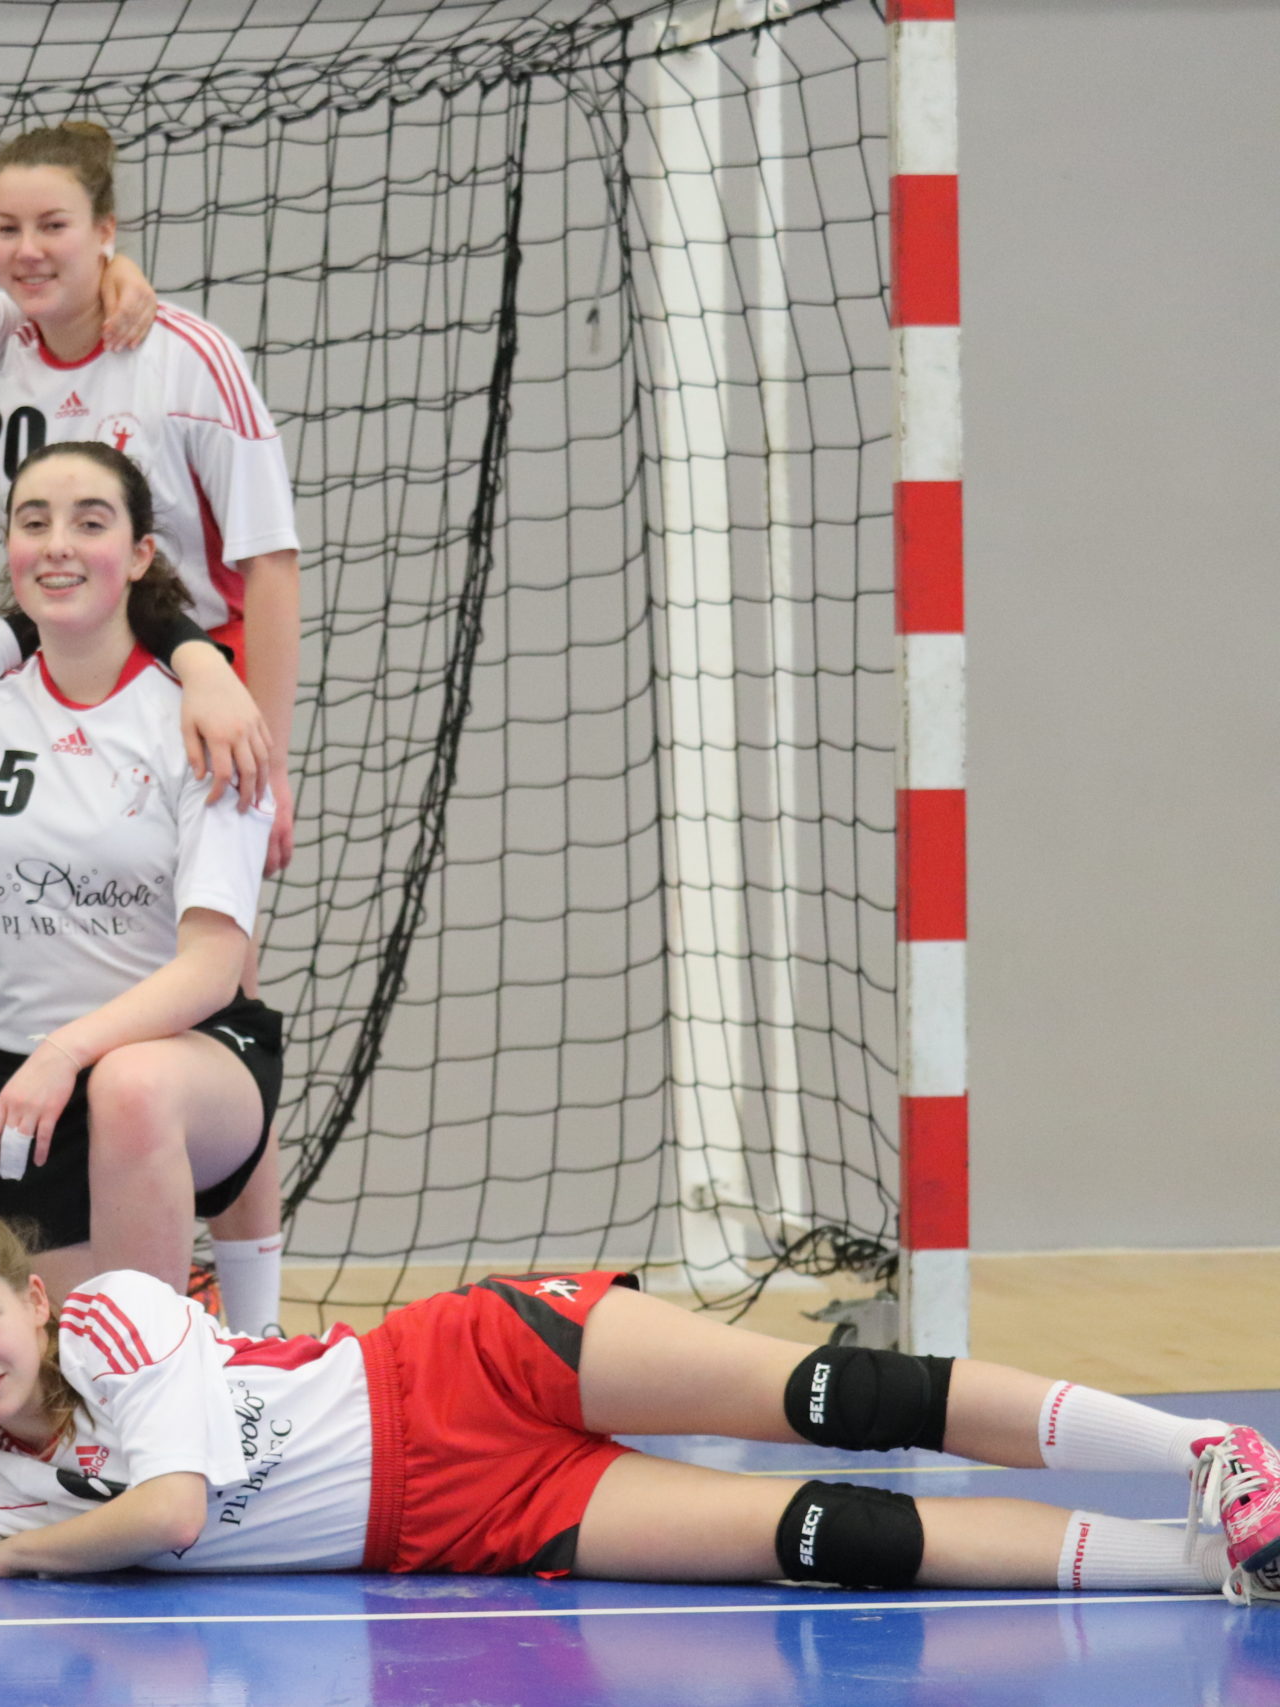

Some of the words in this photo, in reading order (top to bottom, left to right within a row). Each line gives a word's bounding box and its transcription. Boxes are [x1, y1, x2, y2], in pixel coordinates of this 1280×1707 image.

[54, 407, 91, 420] adidas
[51, 743, 94, 757] adidas
[809, 1362, 832, 1425] SELECT
[799, 1504, 825, 1567] SELECT
